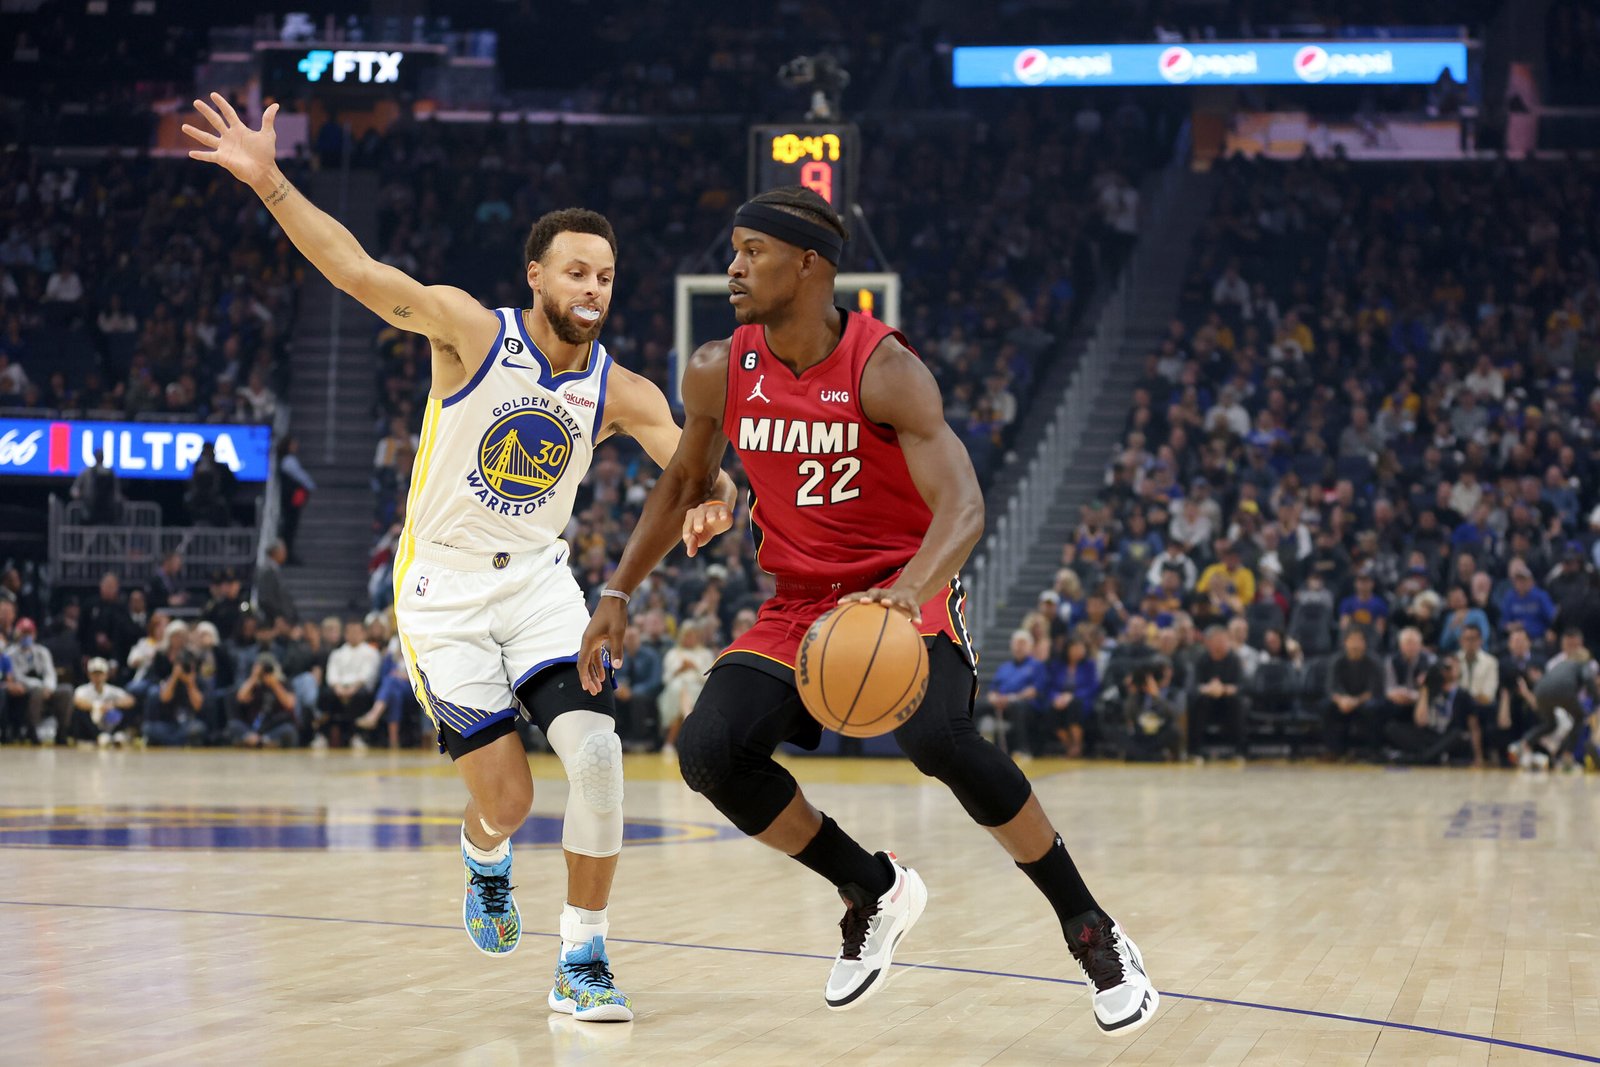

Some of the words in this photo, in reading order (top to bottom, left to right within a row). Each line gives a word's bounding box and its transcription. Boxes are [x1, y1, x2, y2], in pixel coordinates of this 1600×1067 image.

[333, 51, 402, 83] FTX
[744, 353, 756, 369] 6
[820, 391, 849, 403] UKG
[492, 397, 550, 417] GOLDEN
[554, 405, 582, 440] STATE
[739, 417, 860, 454] MIAMI
[82, 430, 241, 472] ULTRA
[533, 439, 566, 467] 30
[466, 469, 556, 516] WARRIORS
[796, 456, 861, 507] 22
